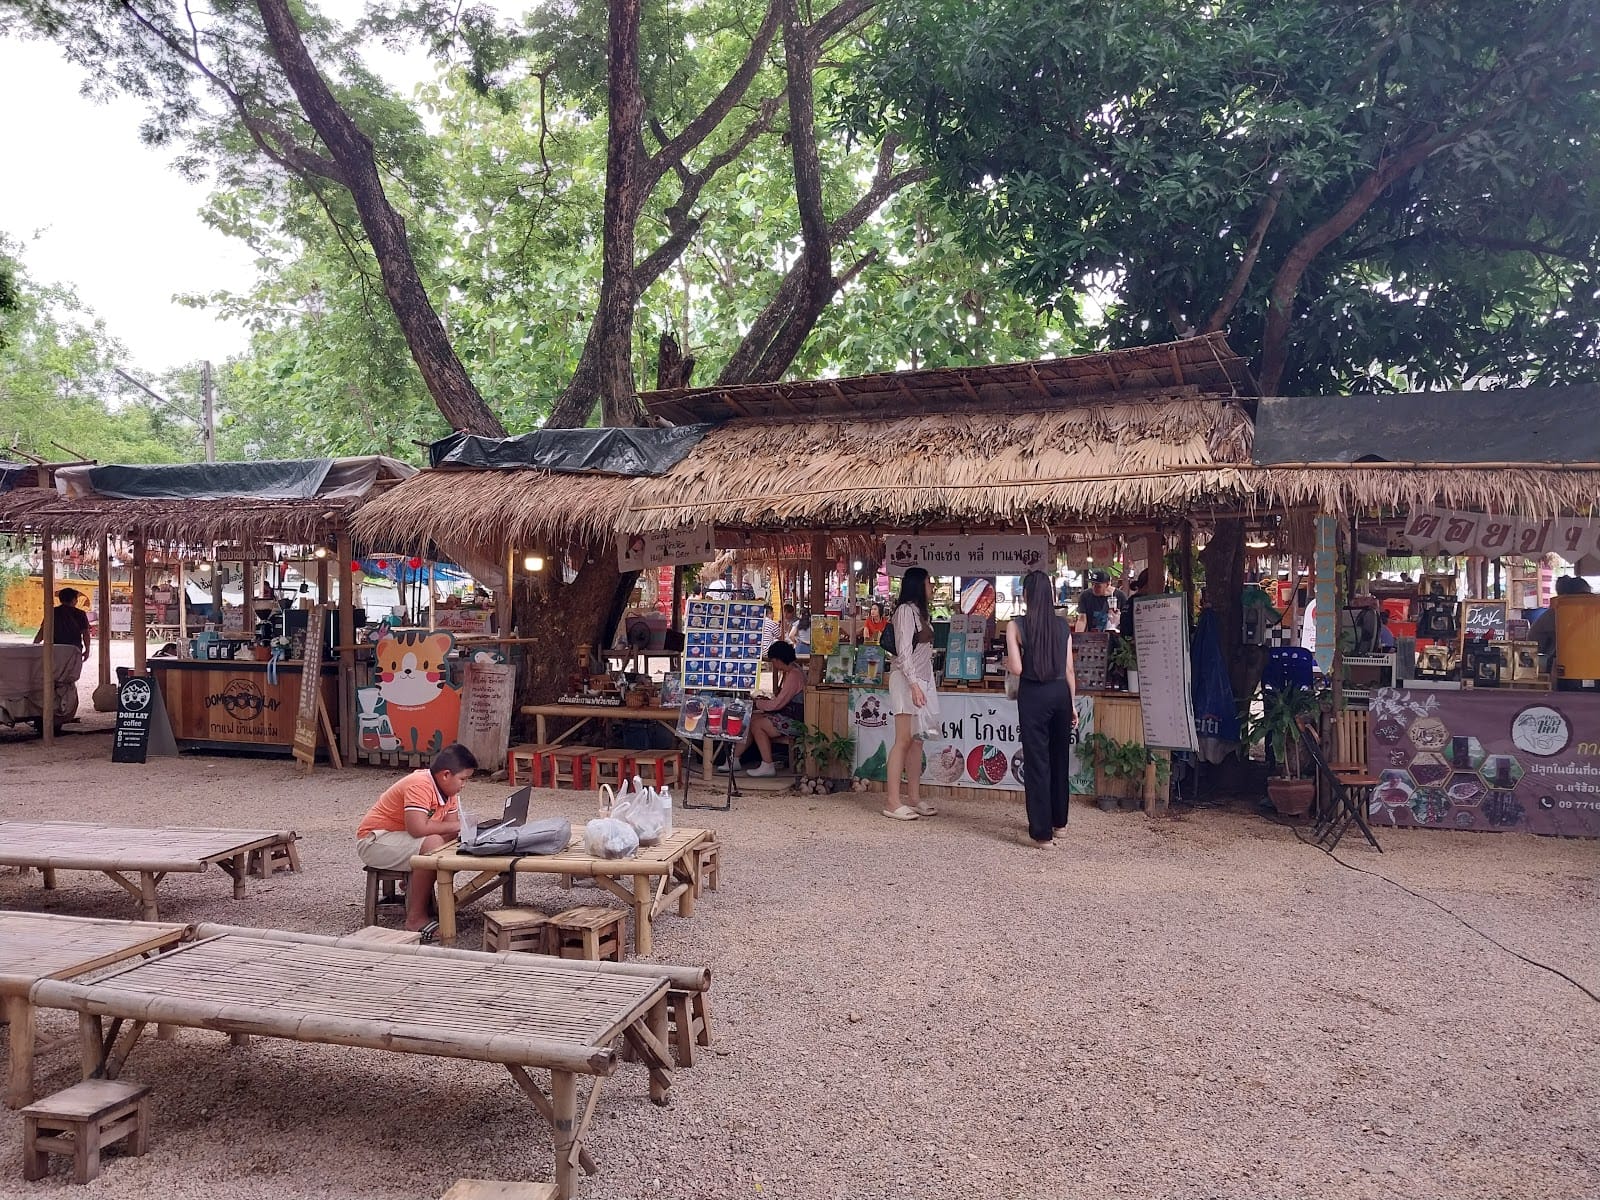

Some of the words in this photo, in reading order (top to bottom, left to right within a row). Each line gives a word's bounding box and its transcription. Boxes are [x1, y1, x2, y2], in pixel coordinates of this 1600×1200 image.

[211, 722, 234, 734] กาแฟ
[1577, 742, 1600, 756] กา
[1531, 761, 1600, 776] ปลูกในพื้นที่ด
[1558, 801, 1573, 809] 09
